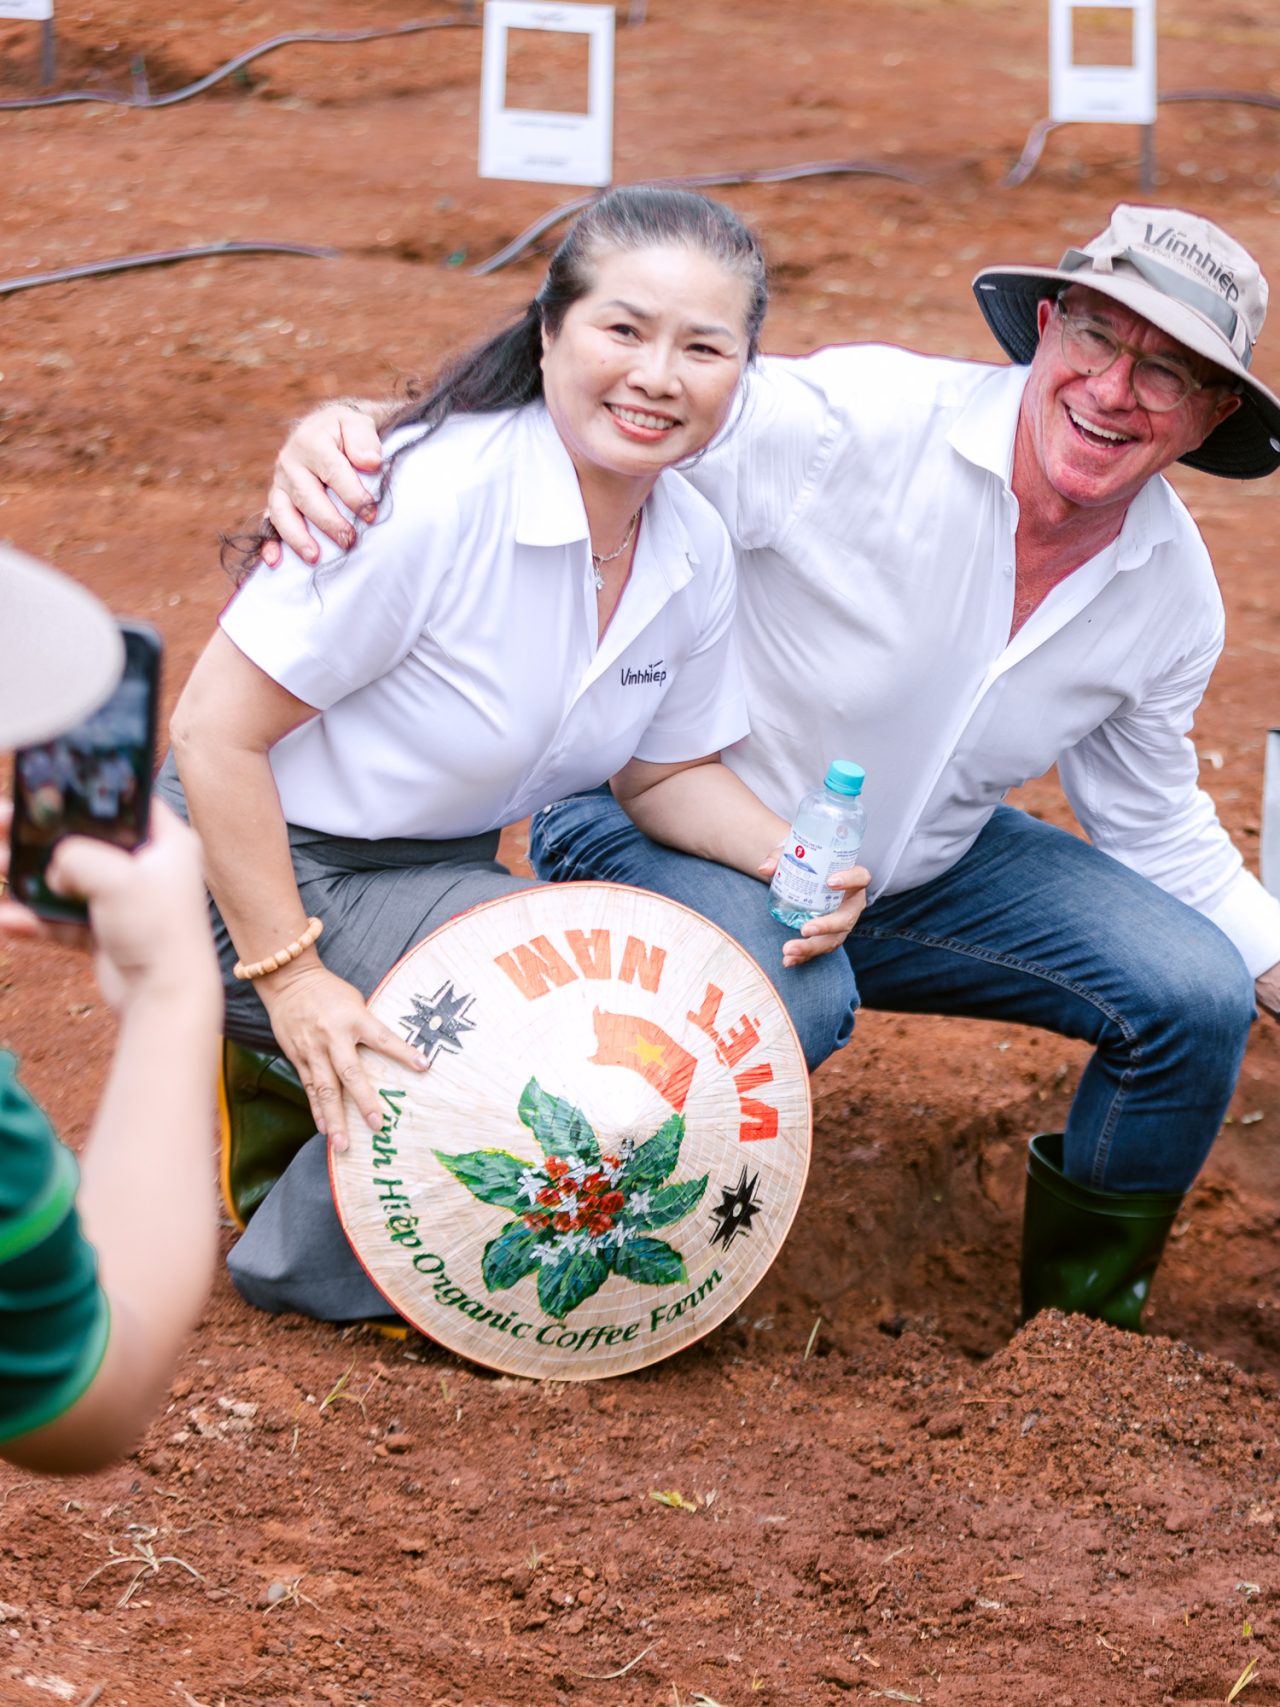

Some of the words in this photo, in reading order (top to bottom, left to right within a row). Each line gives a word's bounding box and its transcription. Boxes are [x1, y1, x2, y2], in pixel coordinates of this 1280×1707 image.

[493, 929, 667, 1001] NAM
[373, 1178, 423, 1248] Hiệp
[412, 1253, 532, 1340] Organic
[536, 1322, 640, 1352] Coffee
[650, 1269, 722, 1332] Farm
